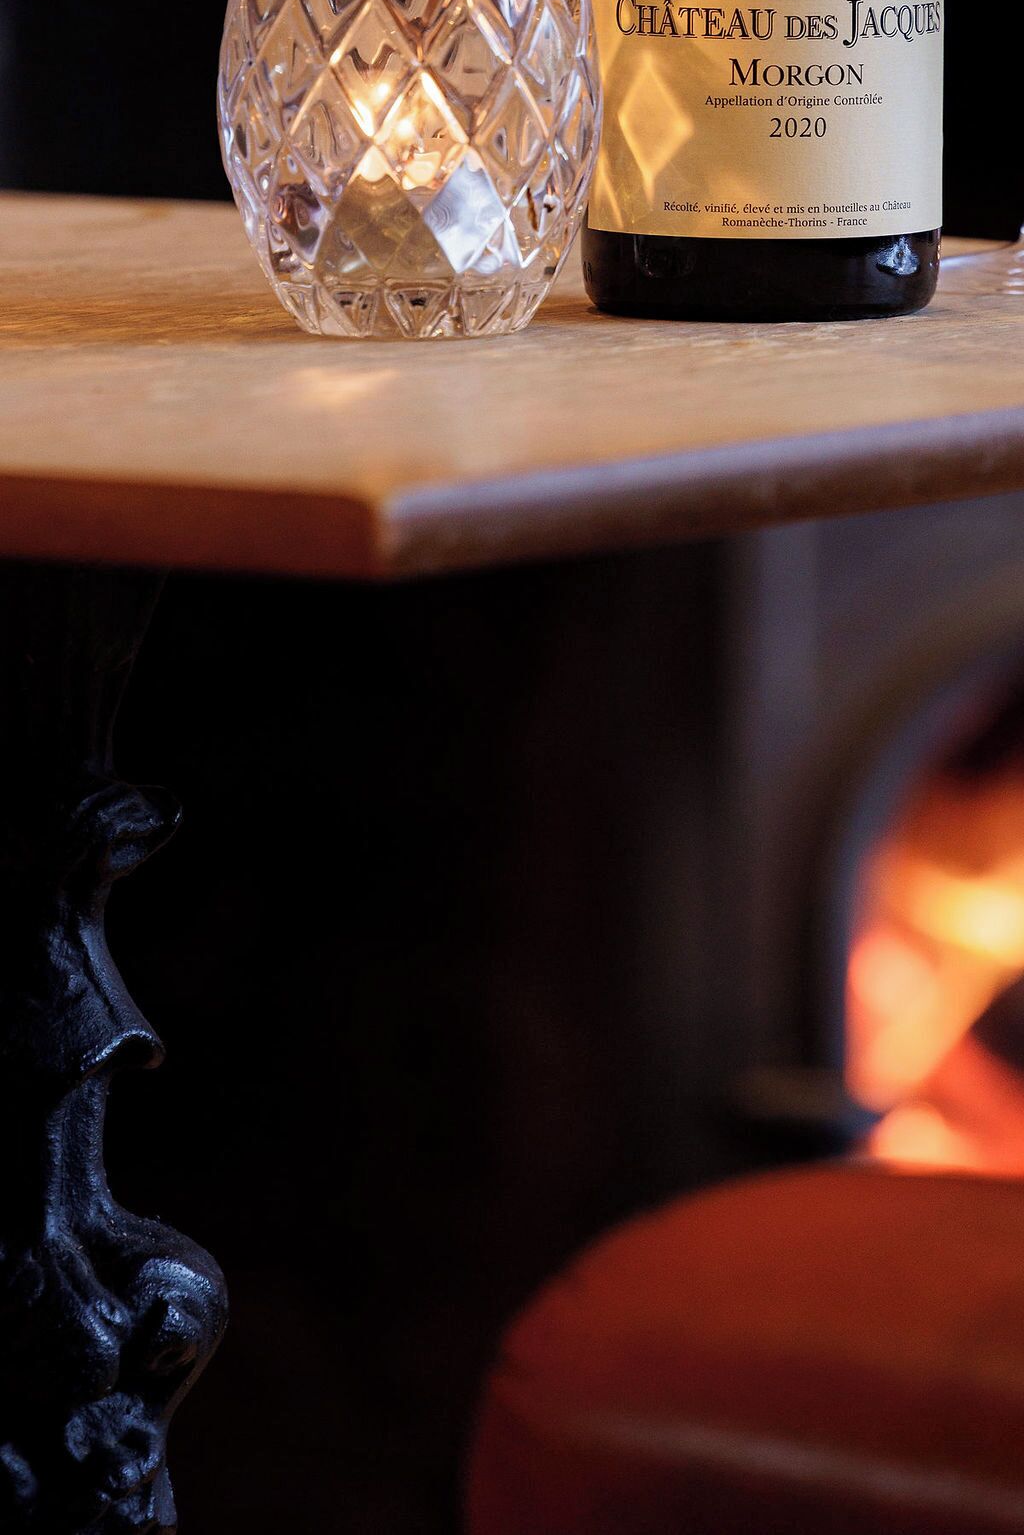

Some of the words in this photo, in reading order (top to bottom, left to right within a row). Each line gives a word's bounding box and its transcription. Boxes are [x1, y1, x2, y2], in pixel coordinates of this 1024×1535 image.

[784, 15, 839, 40] DES
[729, 58, 864, 86] MORGON
[705, 95, 773, 108] Appellation
[776, 95, 830, 109] d'Origine
[833, 93, 883, 106] Contrôlée
[769, 117, 827, 138] 2020
[664, 201, 701, 213] Récolté,
[704, 204, 740, 214] vinifié,
[743, 203, 770, 214] élevé
[773, 204, 783, 214] et
[786, 203, 805, 214] mis
[808, 205, 820, 213] en
[823, 202, 868, 213] bouteilles
[870, 203, 880, 211] au
[882, 200, 911, 211] Château
[722, 217, 827, 227] Romanèche-Thorins
[837, 217, 868, 227] France
